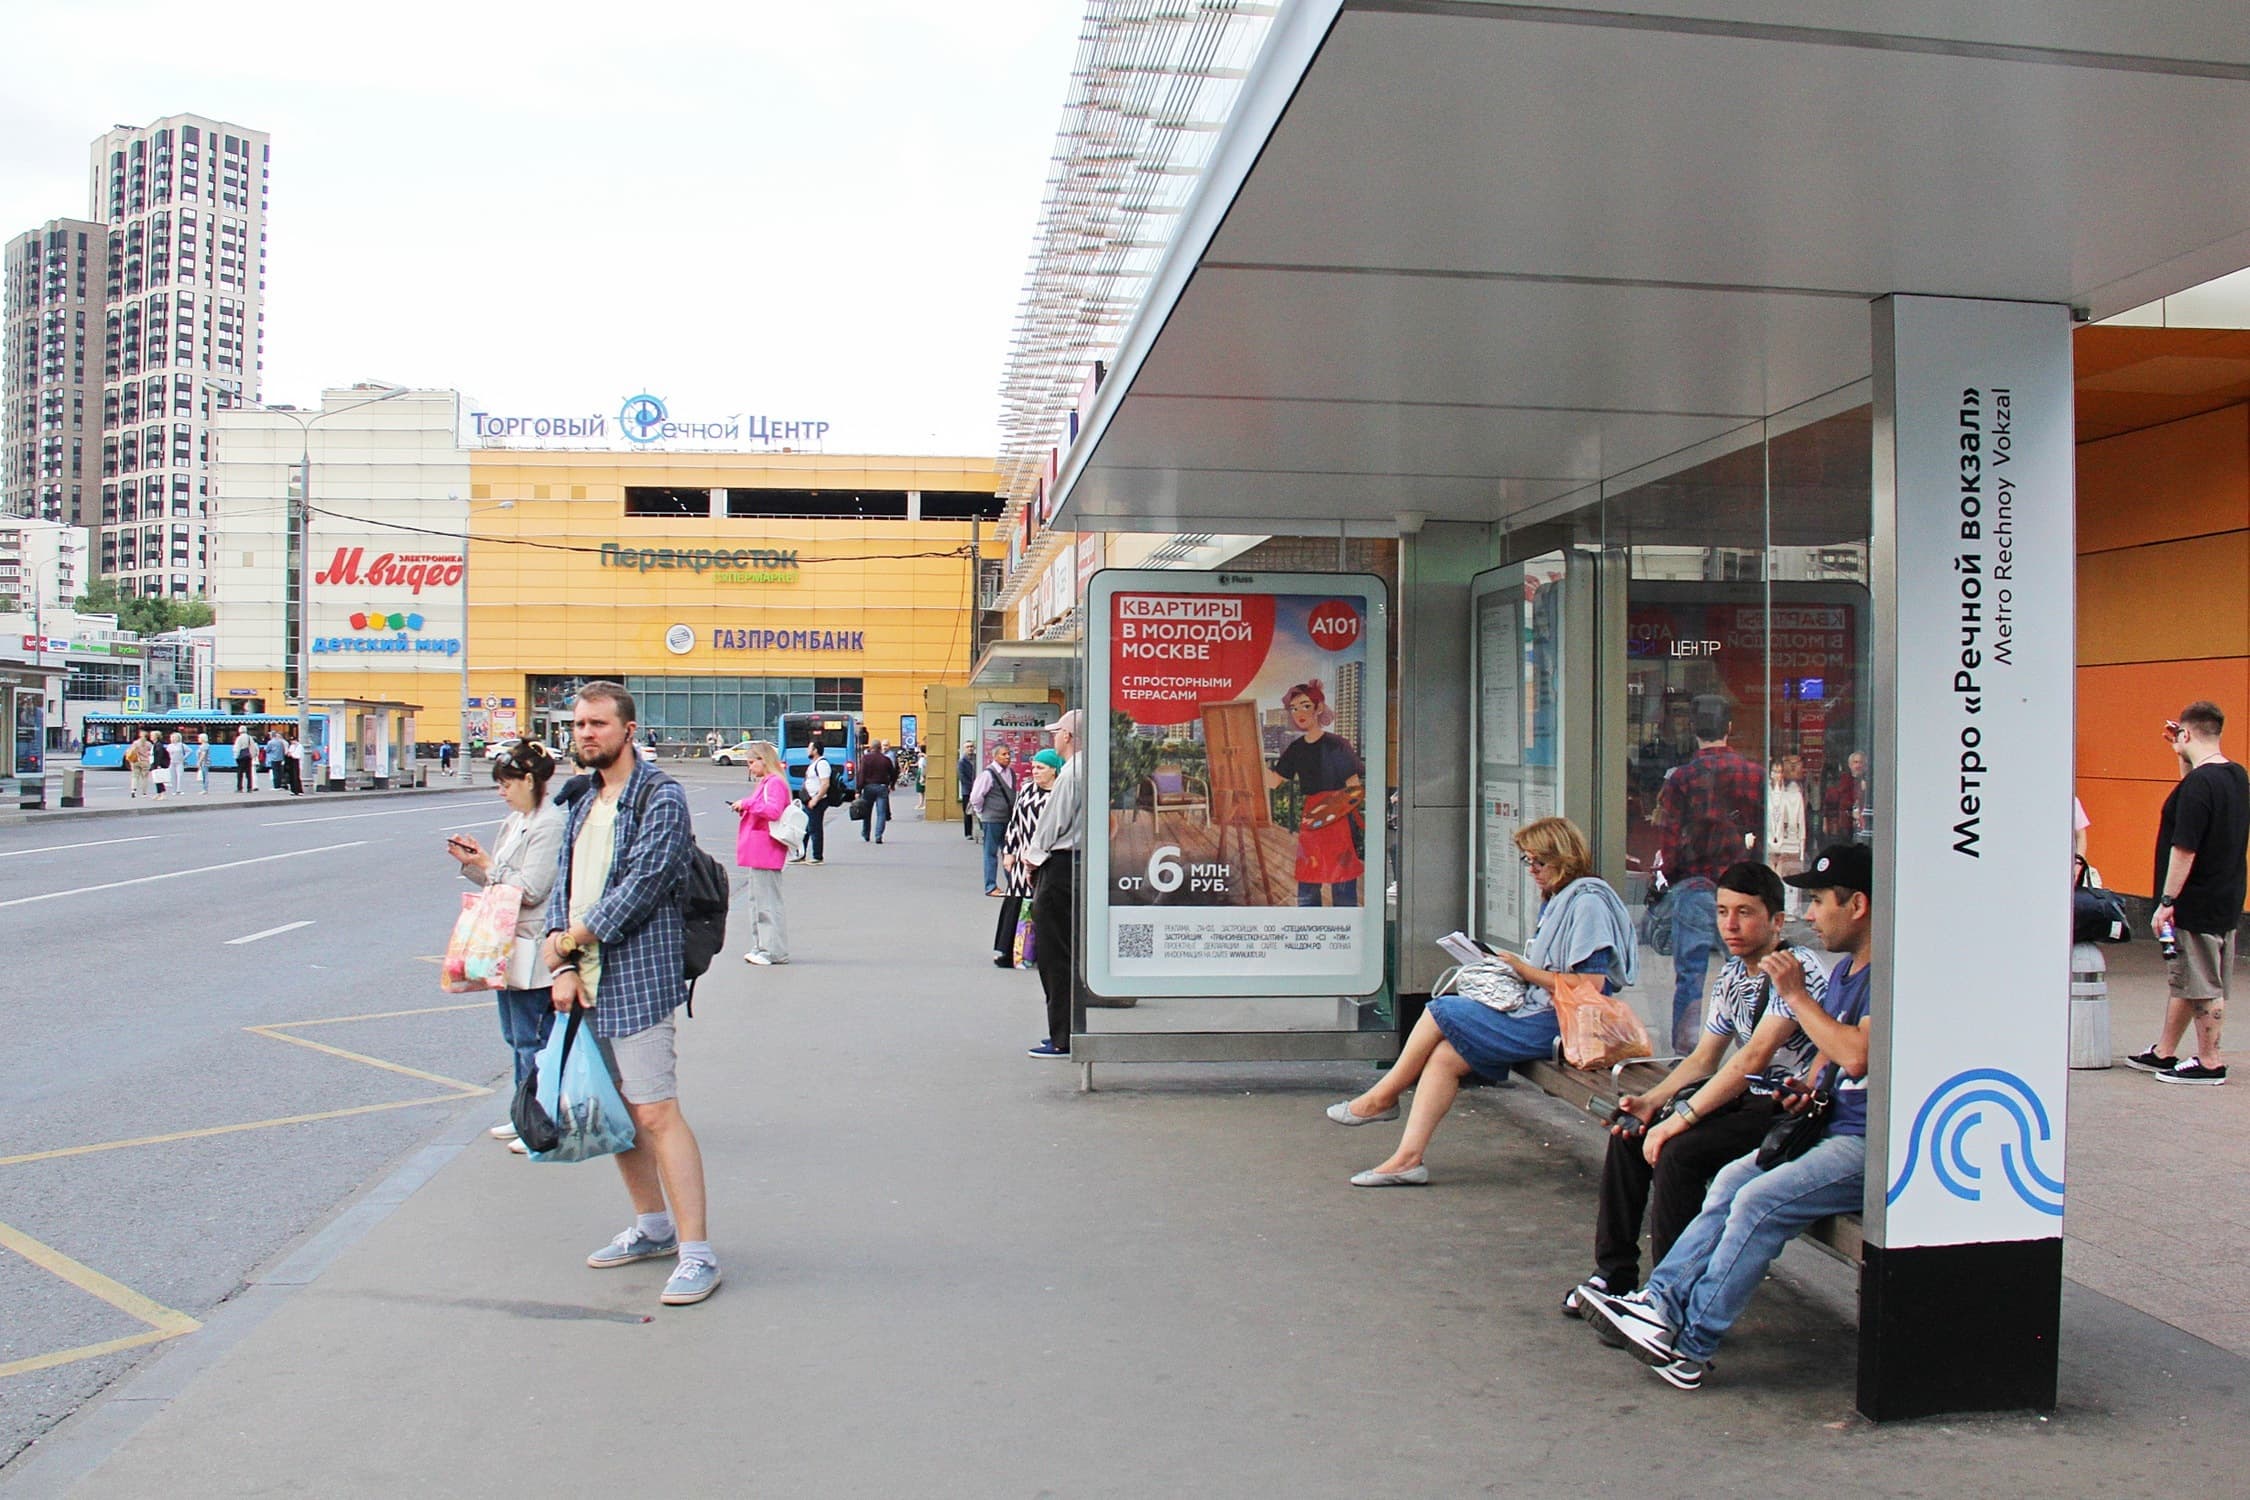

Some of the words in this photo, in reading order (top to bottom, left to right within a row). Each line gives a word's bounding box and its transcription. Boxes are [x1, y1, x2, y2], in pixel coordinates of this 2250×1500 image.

[1992, 388, 2011, 466] Vokzal
[1957, 387, 1980, 540] вокзал»
[1994, 478, 2015, 580] Rechnoy
[1122, 600, 1238, 617] КВАРТИРЫ
[1123, 624, 1138, 639] В
[1142, 621, 1252, 642] МОЛОДОЙ
[1311, 617, 1357, 635] A101
[1954, 555, 1982, 715] «Речной
[1994, 589, 2012, 665] Metro
[415, 638, 461, 657] мир
[713, 629, 864, 651] ГАЗПРОМБАНК
[1671, 640, 1721, 659] ЦЕНТР
[1122, 644, 1210, 660] МОСКВЕ
[1122, 677, 1130, 687] С
[1133, 677, 1232, 688] ПРОСТОРНЫМИ
[1122, 690, 1197, 701] ТЕРРАСАМИ
[1953, 727, 1987, 858] Метро
[1119, 877, 1142, 892] ОТ
[1148, 846, 1183, 893] 6
[1191, 864, 1229, 878] МЛН
[1191, 879, 1229, 894] РУБ.
